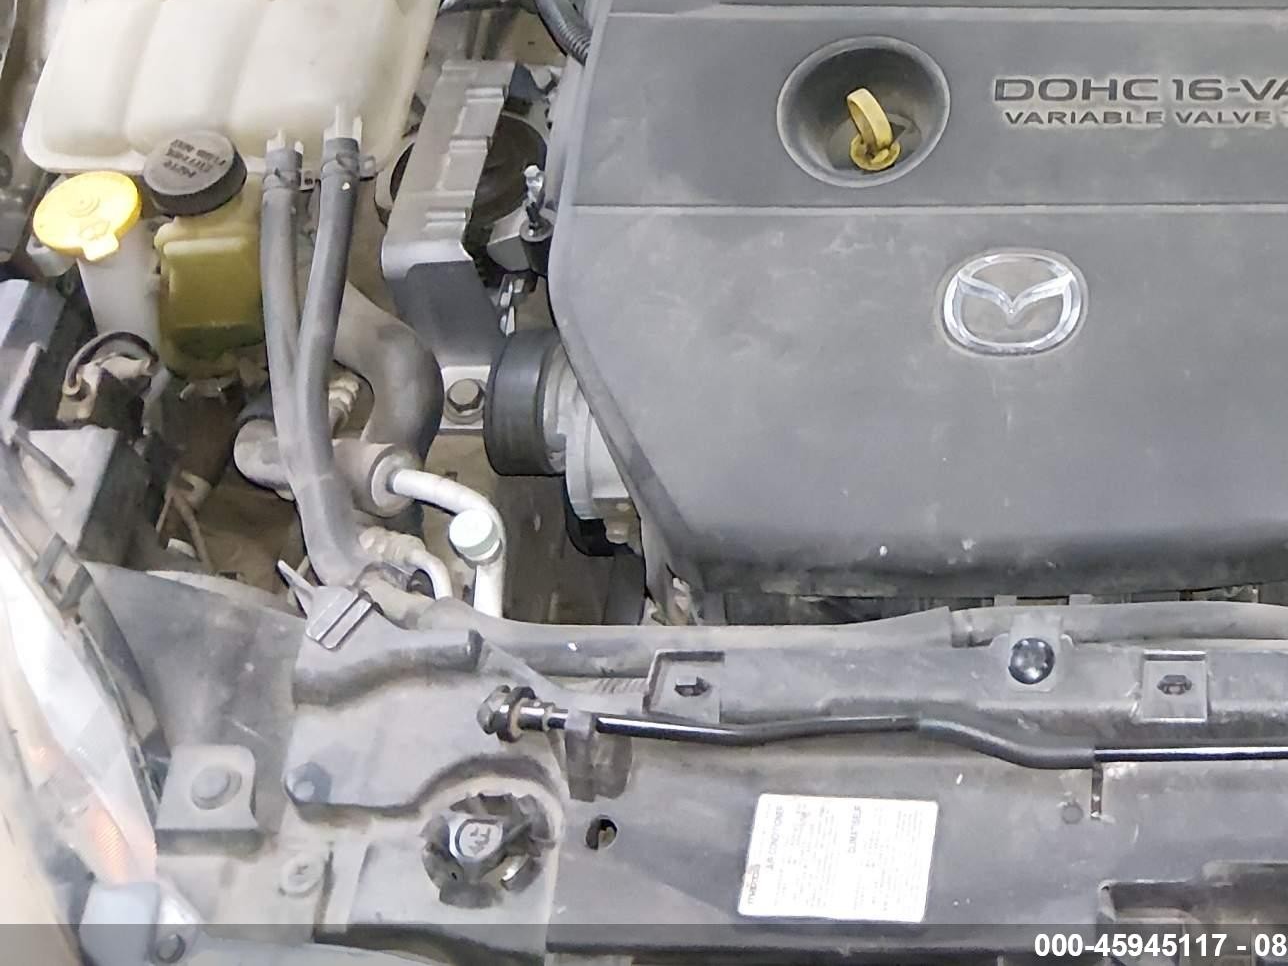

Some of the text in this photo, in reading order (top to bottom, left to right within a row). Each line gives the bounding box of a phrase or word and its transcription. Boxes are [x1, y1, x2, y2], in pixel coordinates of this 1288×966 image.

[994, 78, 1160, 102] DOHC
[1005, 110, 1164, 126] VARIABLE
[1175, 110, 1273, 125] VALVE
